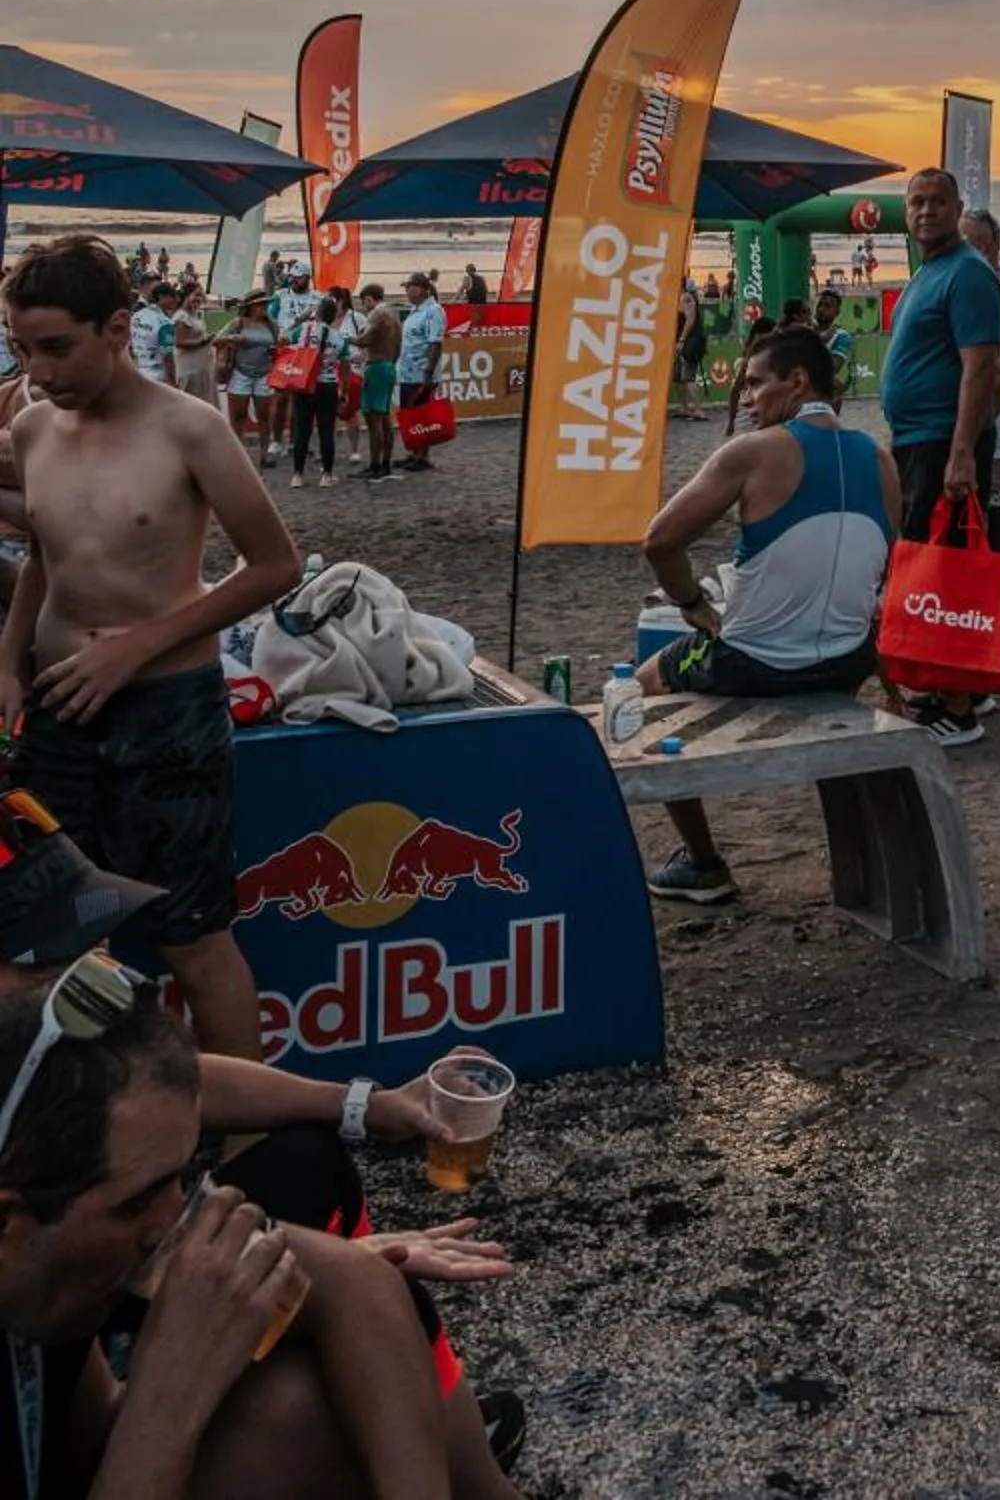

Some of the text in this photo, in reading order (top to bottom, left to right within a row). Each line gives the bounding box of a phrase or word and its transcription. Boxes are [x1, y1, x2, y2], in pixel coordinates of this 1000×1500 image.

[324, 85, 352, 179] edix
[588, 113, 612, 176] HAZLO
[628, 68, 675, 194] Psyllium
[432, 349, 494, 379] ZLO
[434, 379, 497, 401] URAL
[556, 224, 629, 473] HAZLO
[608, 232, 669, 473] NATURAL
[923, 606, 996, 633] credix
[377, 913, 566, 1043] Bull
